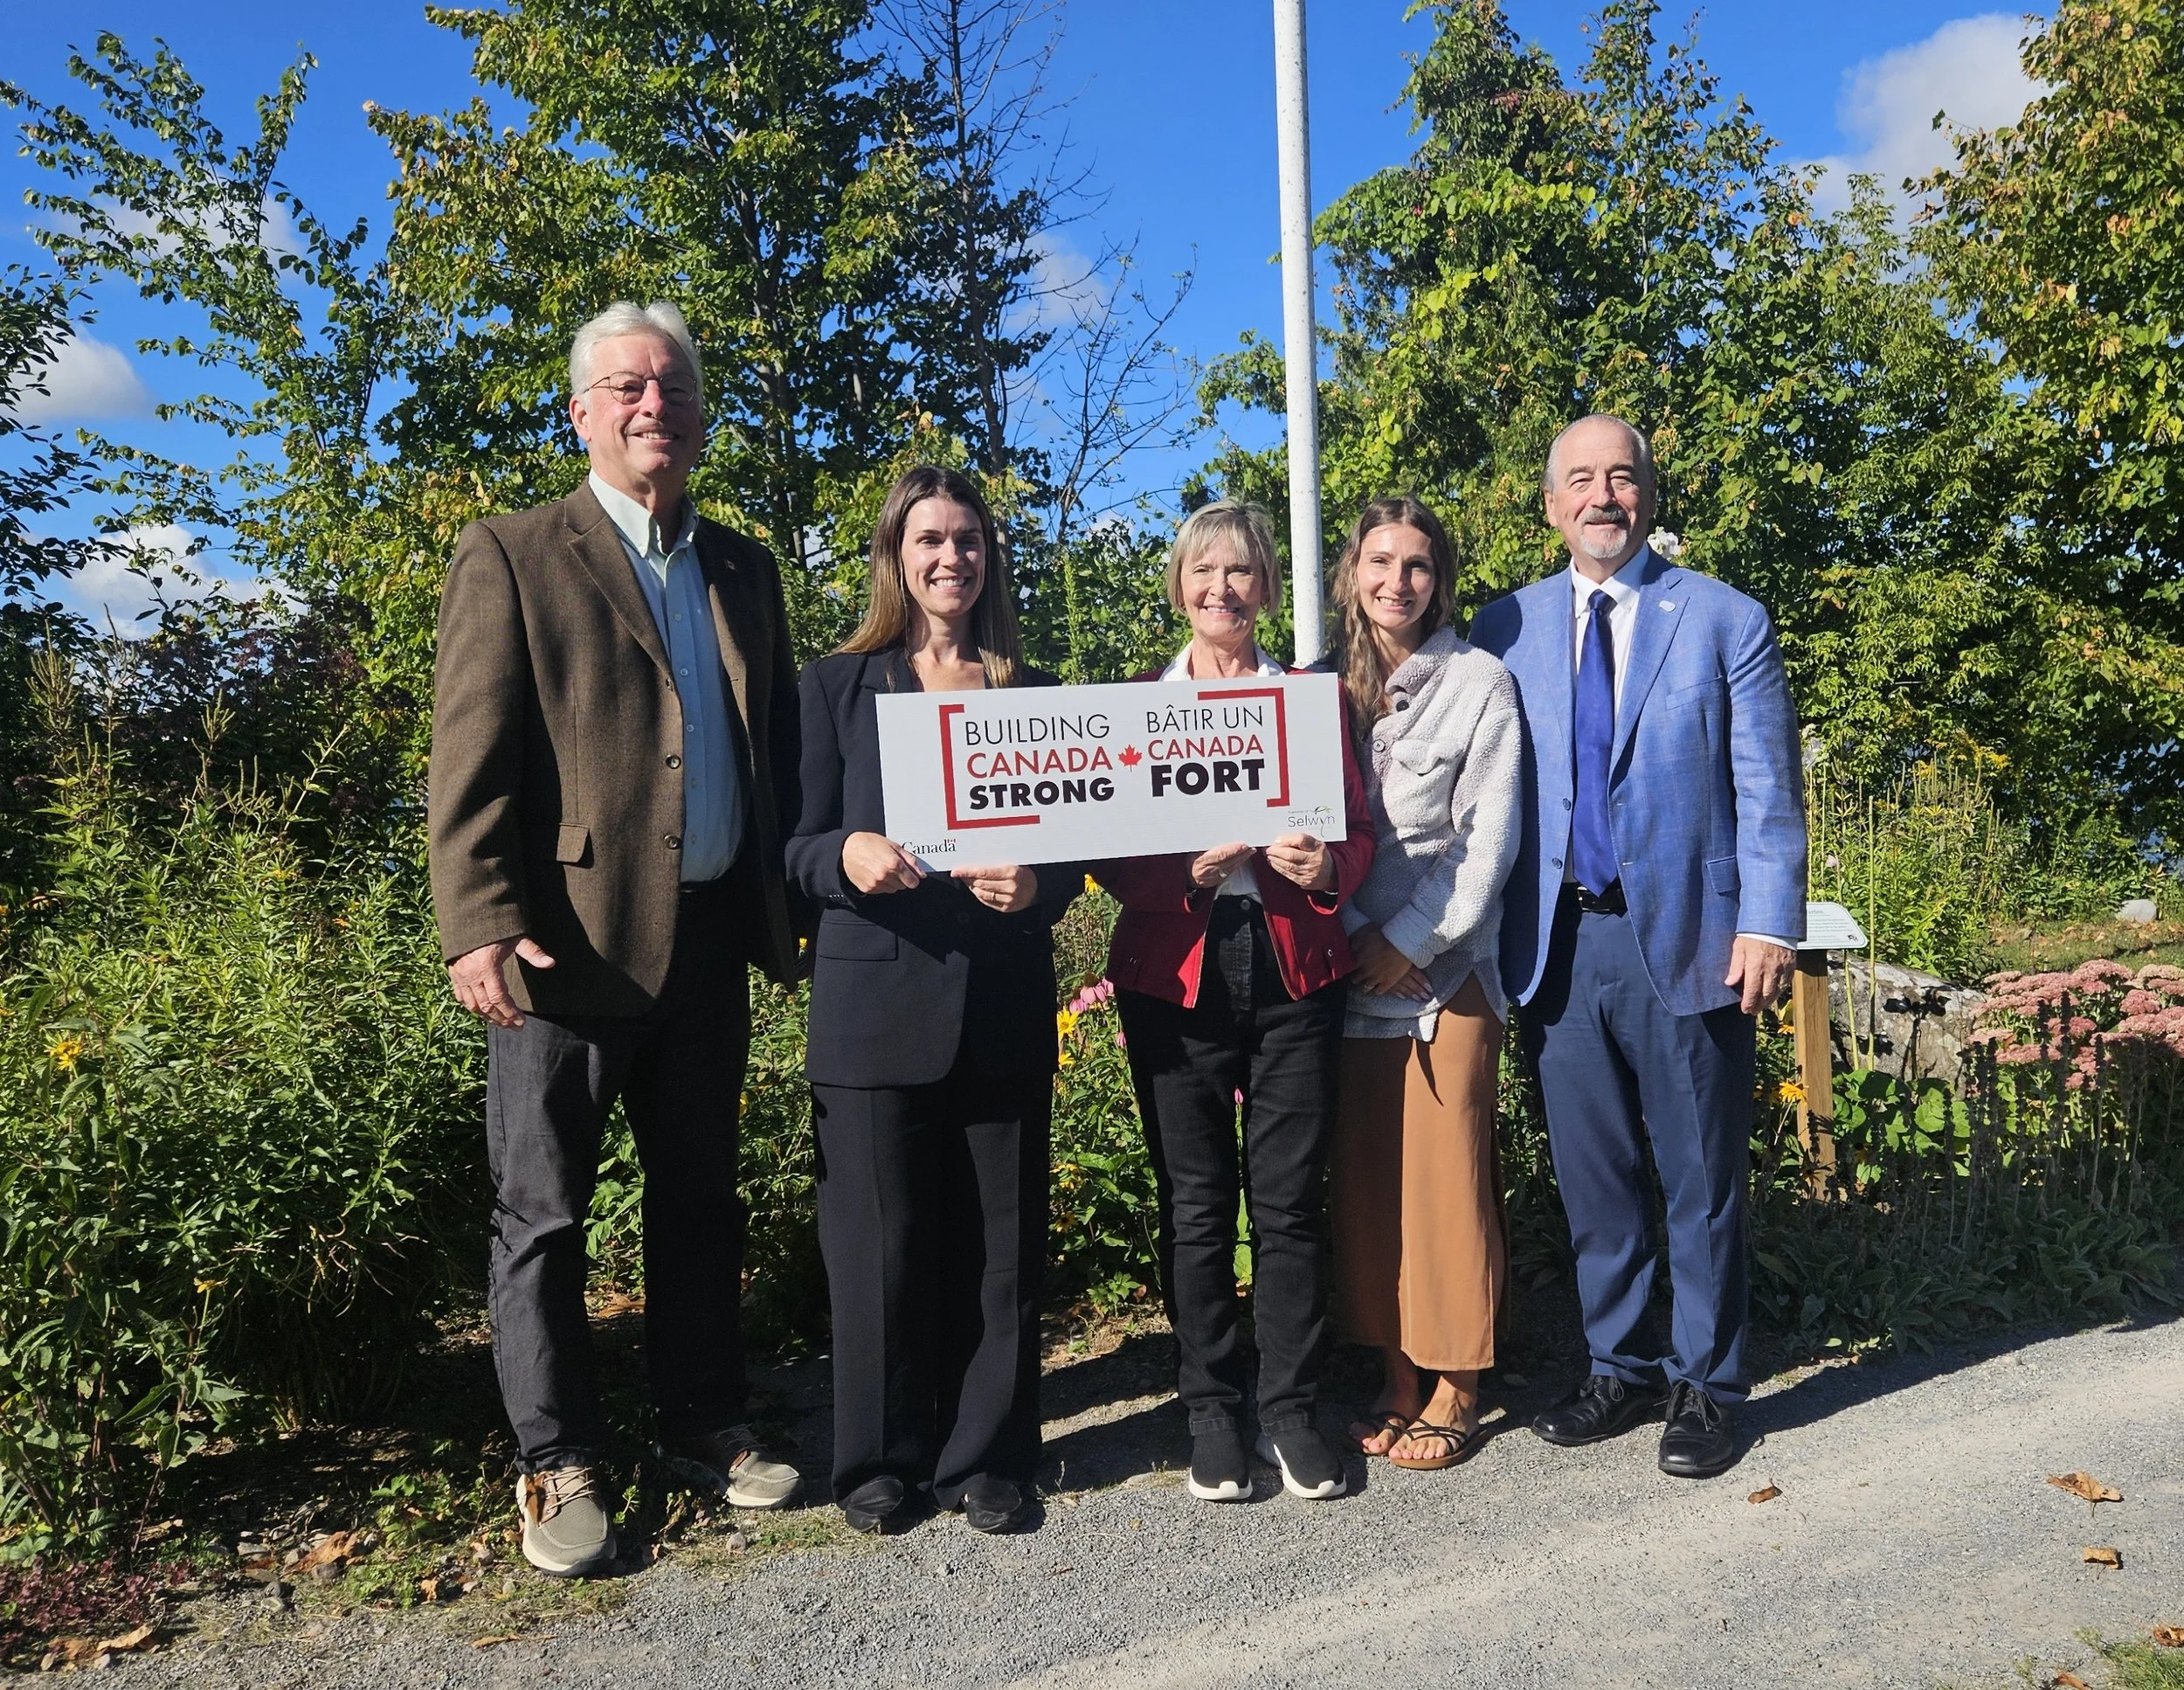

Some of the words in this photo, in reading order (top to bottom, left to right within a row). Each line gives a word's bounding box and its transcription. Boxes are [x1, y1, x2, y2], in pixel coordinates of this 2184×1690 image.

[965, 714, 1109, 745] BUILDING
[1146, 703, 1213, 733] BÂTIR
[1223, 705, 1263, 729] UN
[966, 745, 1113, 779] CANADA
[1147, 734, 1264, 760] CANADA
[1151, 758, 1265, 797] FORT
[970, 777, 1115, 810] STRONG
[1288, 814, 1336, 838] Selwyn
